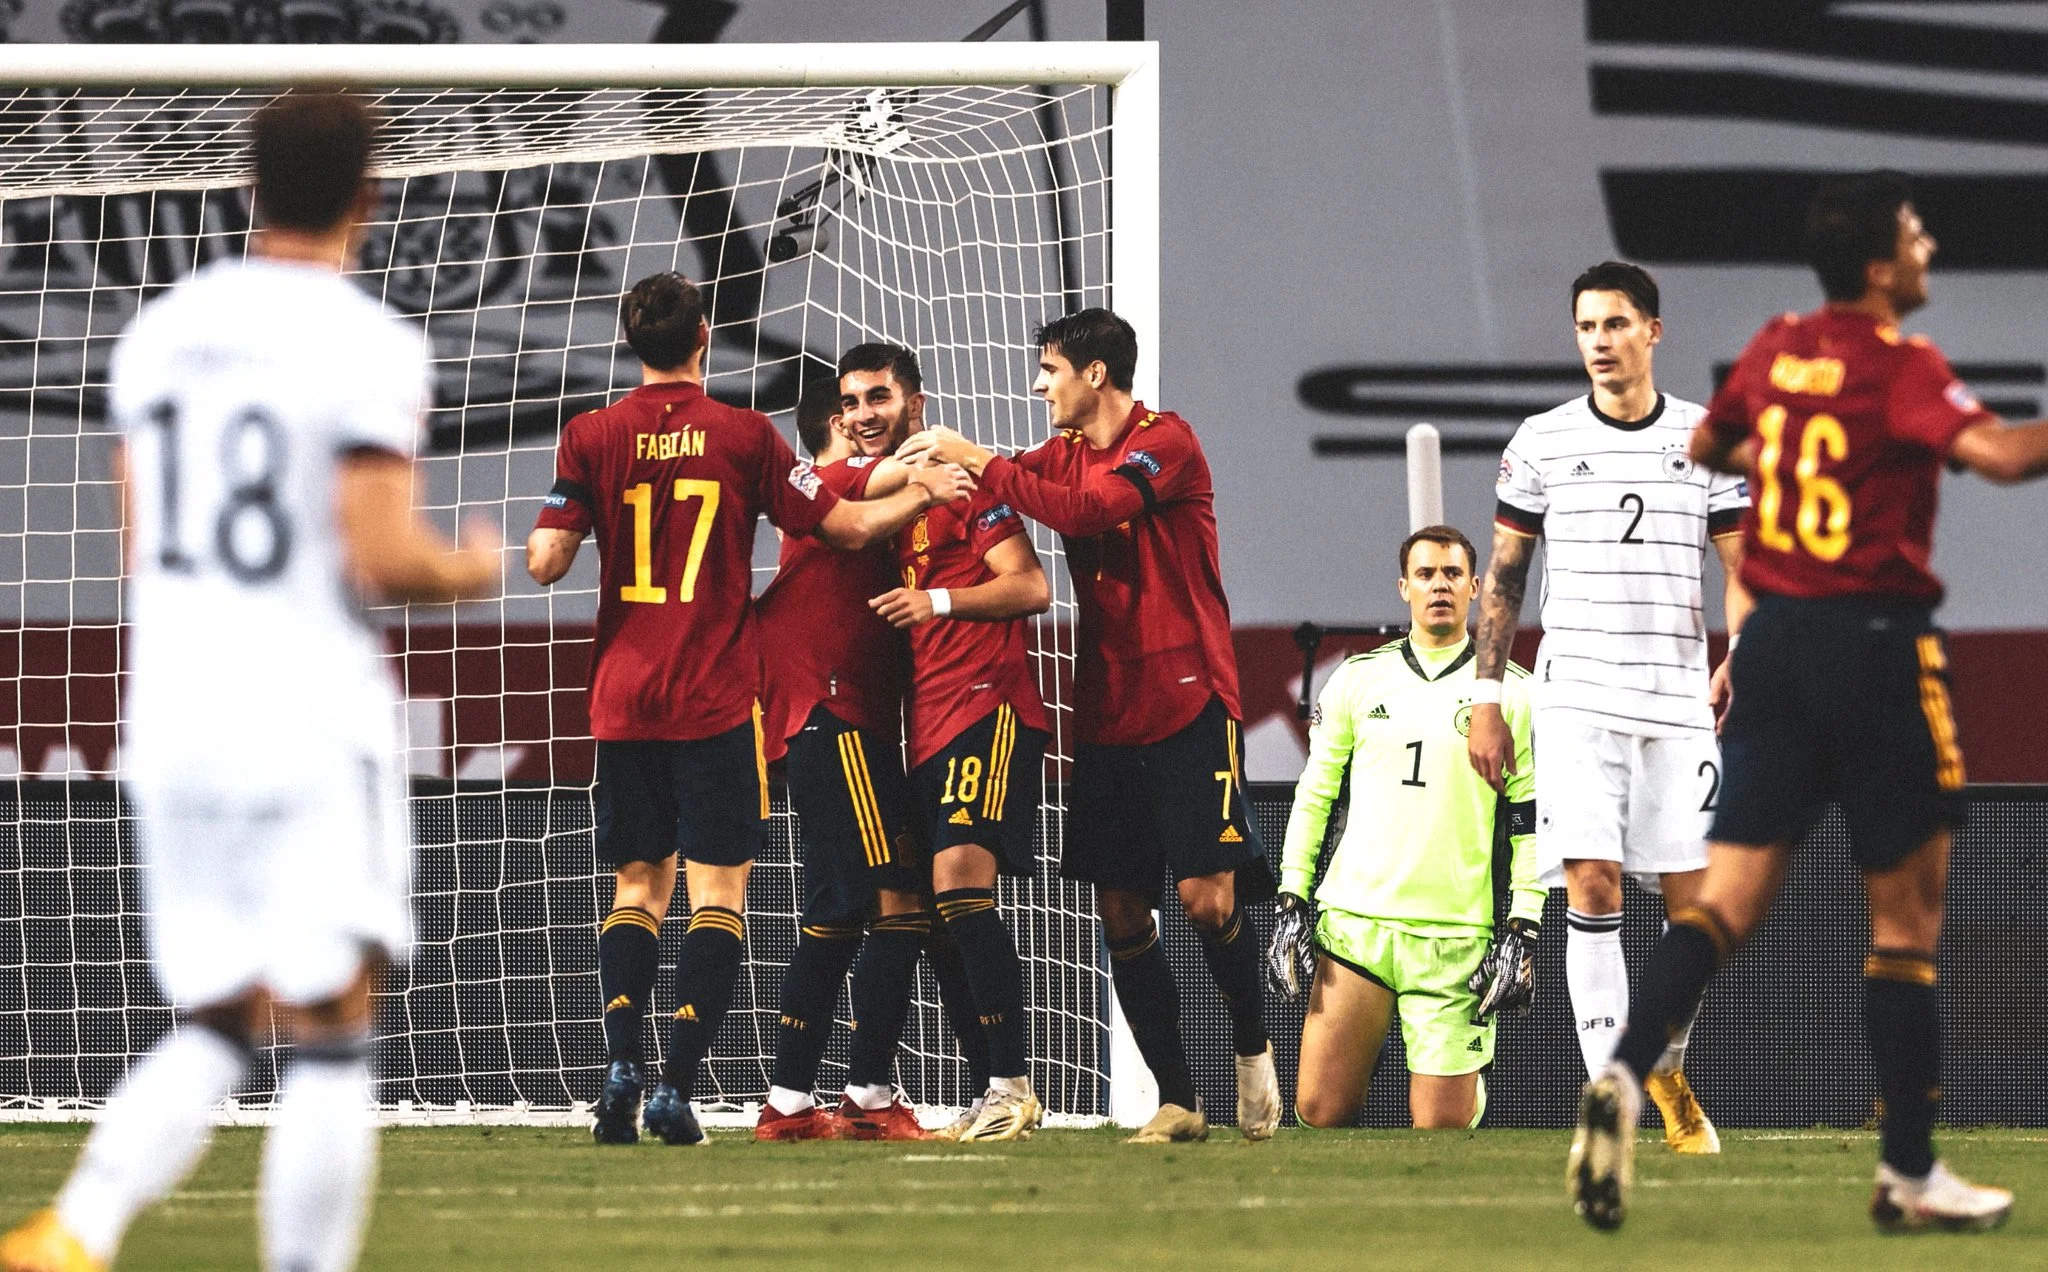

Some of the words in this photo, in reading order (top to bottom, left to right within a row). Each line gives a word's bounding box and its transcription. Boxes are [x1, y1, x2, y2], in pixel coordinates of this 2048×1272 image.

[636, 424, 706, 460] FABIÁN
[147, 395, 291, 584] 18
[1756, 403, 1852, 562] 16
[620, 478, 721, 604] 17
[1619, 493, 1645, 544] 2
[1367, 712, 1390, 720] adidas
[941, 756, 982, 804] 18
[1401, 740, 1426, 788] 1
[1698, 760, 1720, 812] 2
[1214, 771, 1232, 820] 7
[1581, 1017, 1615, 1031] DFB
